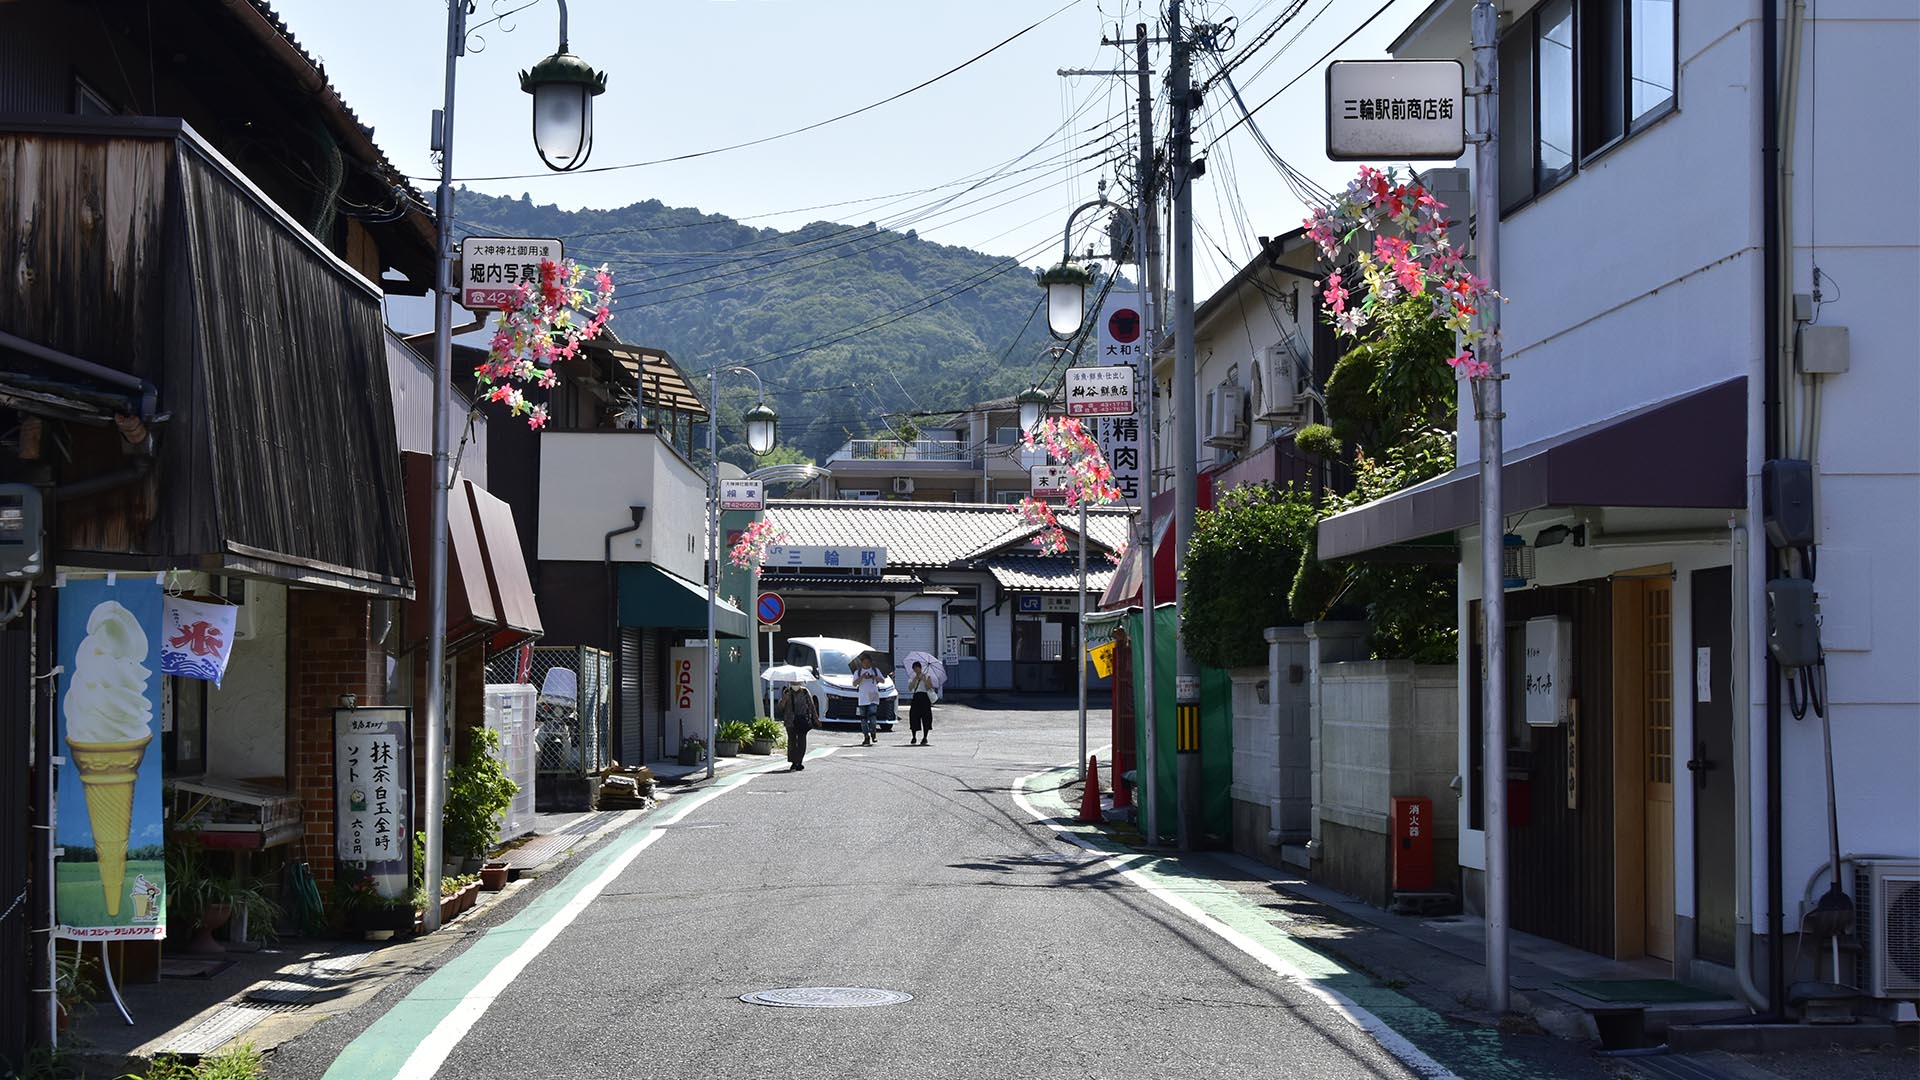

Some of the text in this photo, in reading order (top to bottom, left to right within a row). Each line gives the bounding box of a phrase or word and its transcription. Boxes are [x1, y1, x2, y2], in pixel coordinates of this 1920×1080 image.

[1344, 98, 1453, 120] 三輪駅前商店街
[473, 245, 550, 257] 大神神社御用達
[470, 263, 544, 284] 堀内写真
[770, 546, 876, 567] JR 三輪駅
[1023, 599, 1039, 609] JR
[680, 660, 694, 709] DyDo
[348, 746, 359, 783] ソフト
[370, 741, 393, 851] 抹茶白玉金時
[1409, 804, 1420, 837] 消火器
